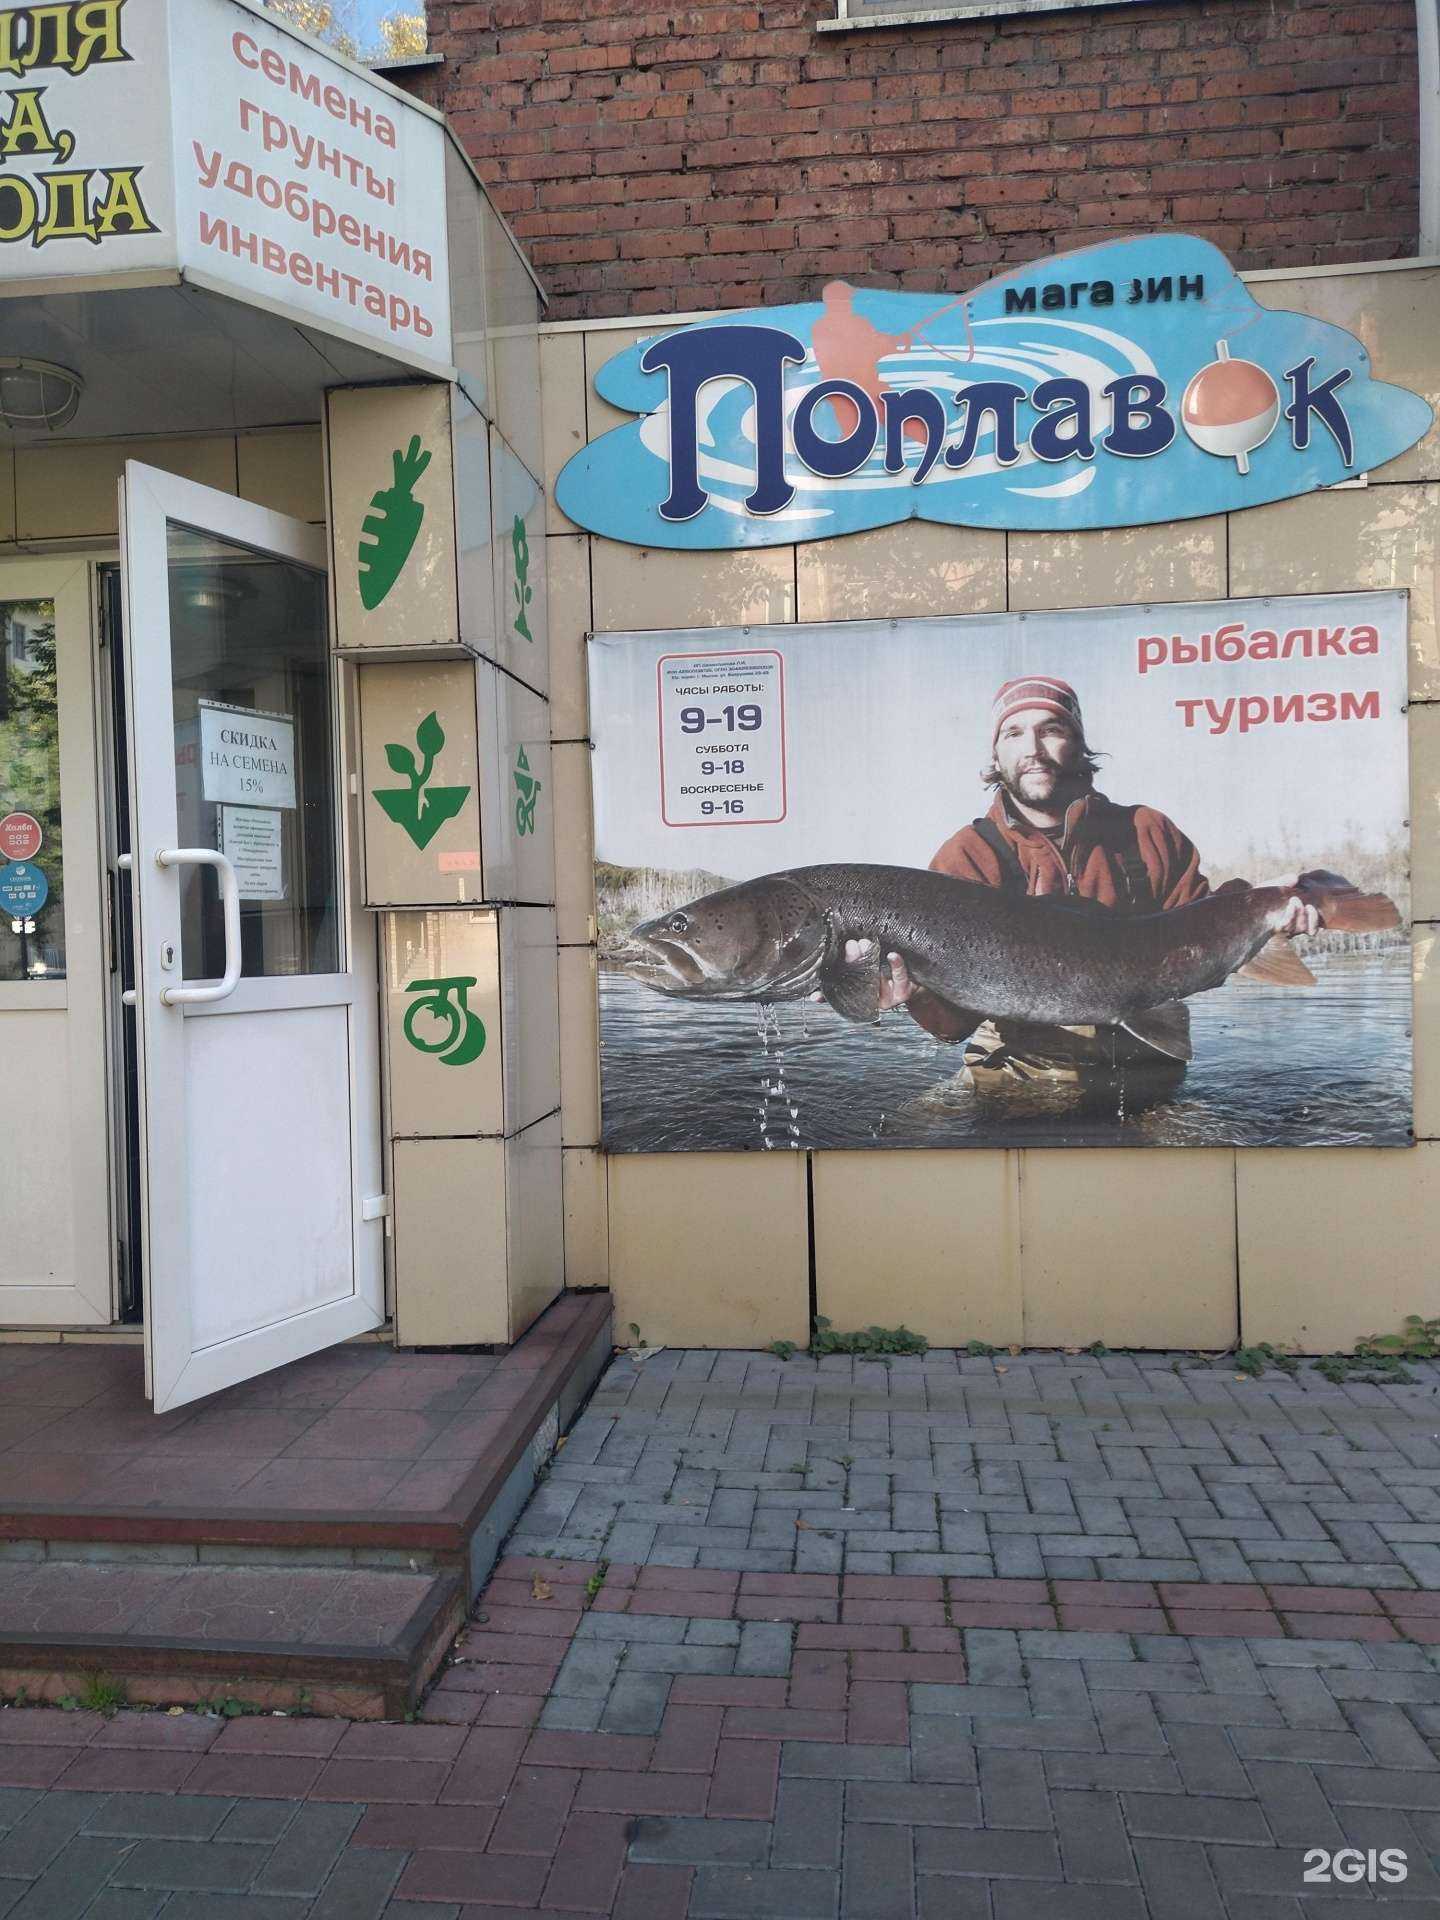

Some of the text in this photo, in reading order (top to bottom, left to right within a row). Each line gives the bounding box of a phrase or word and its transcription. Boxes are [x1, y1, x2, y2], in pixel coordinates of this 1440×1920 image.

[231, 31, 397, 149] семена
[239, 98, 396, 206] грунты
[193, 140, 433, 282] удобрения
[199, 211, 434, 338] инвентарь
[1004, 274, 1205, 314] магазин
[1137, 623, 1379, 674] рыбалка
[675, 684, 765, 696] ЧАСЫ РАБОТЫ:
[680, 704, 762, 734] 9-19
[1175, 690, 1380, 735] туризм
[220, 729, 278, 751] СКИДКА
[695, 744, 750, 754] СУББОТА
[209, 751, 230, 767] НА
[232, 754, 288, 775] СЕМЕНА
[701, 759, 745, 775] 9-18
[239, 778, 264, 794] 15%
[680, 783, 765, 794] ВОСКРЕСЕНЬЕ
[701, 799, 744, 815] 9-16
